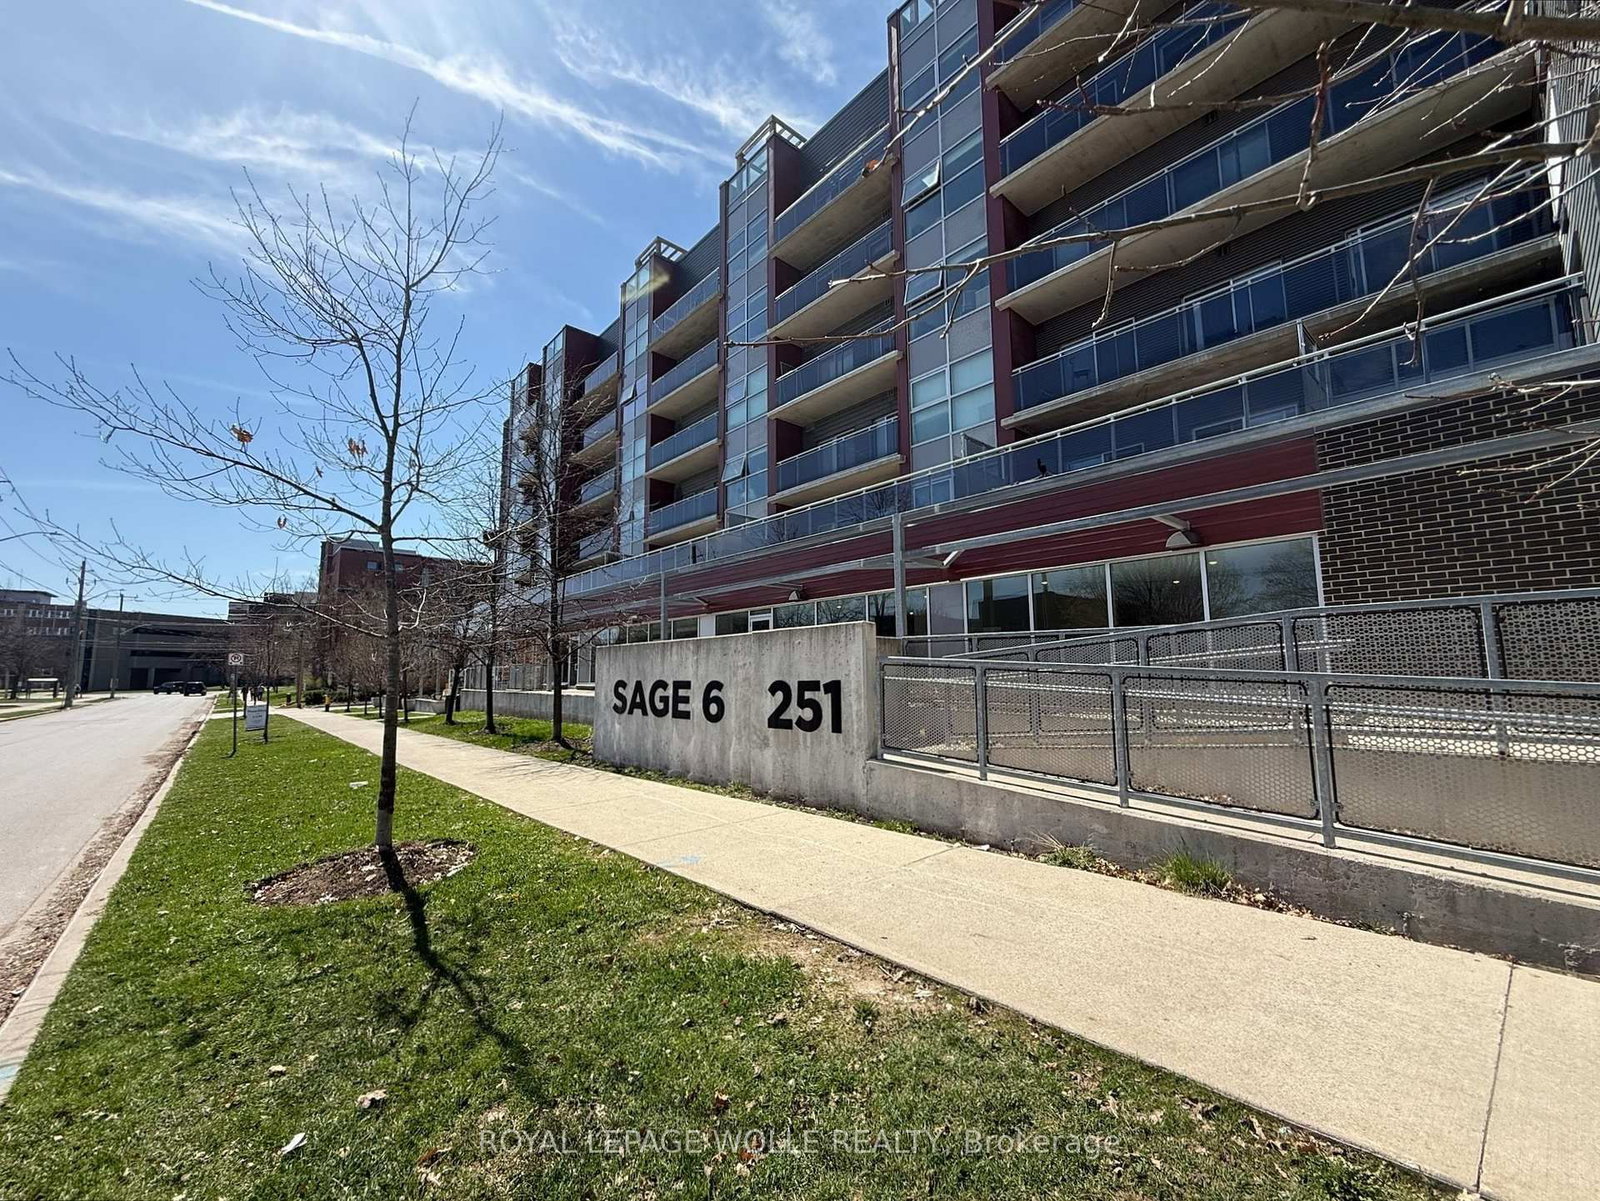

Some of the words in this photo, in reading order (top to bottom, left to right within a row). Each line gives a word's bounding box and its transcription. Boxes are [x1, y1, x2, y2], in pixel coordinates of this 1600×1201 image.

[612, 679, 692, 720] SAGE
[702, 680, 725, 723] 6
[767, 680, 842, 734] 251
